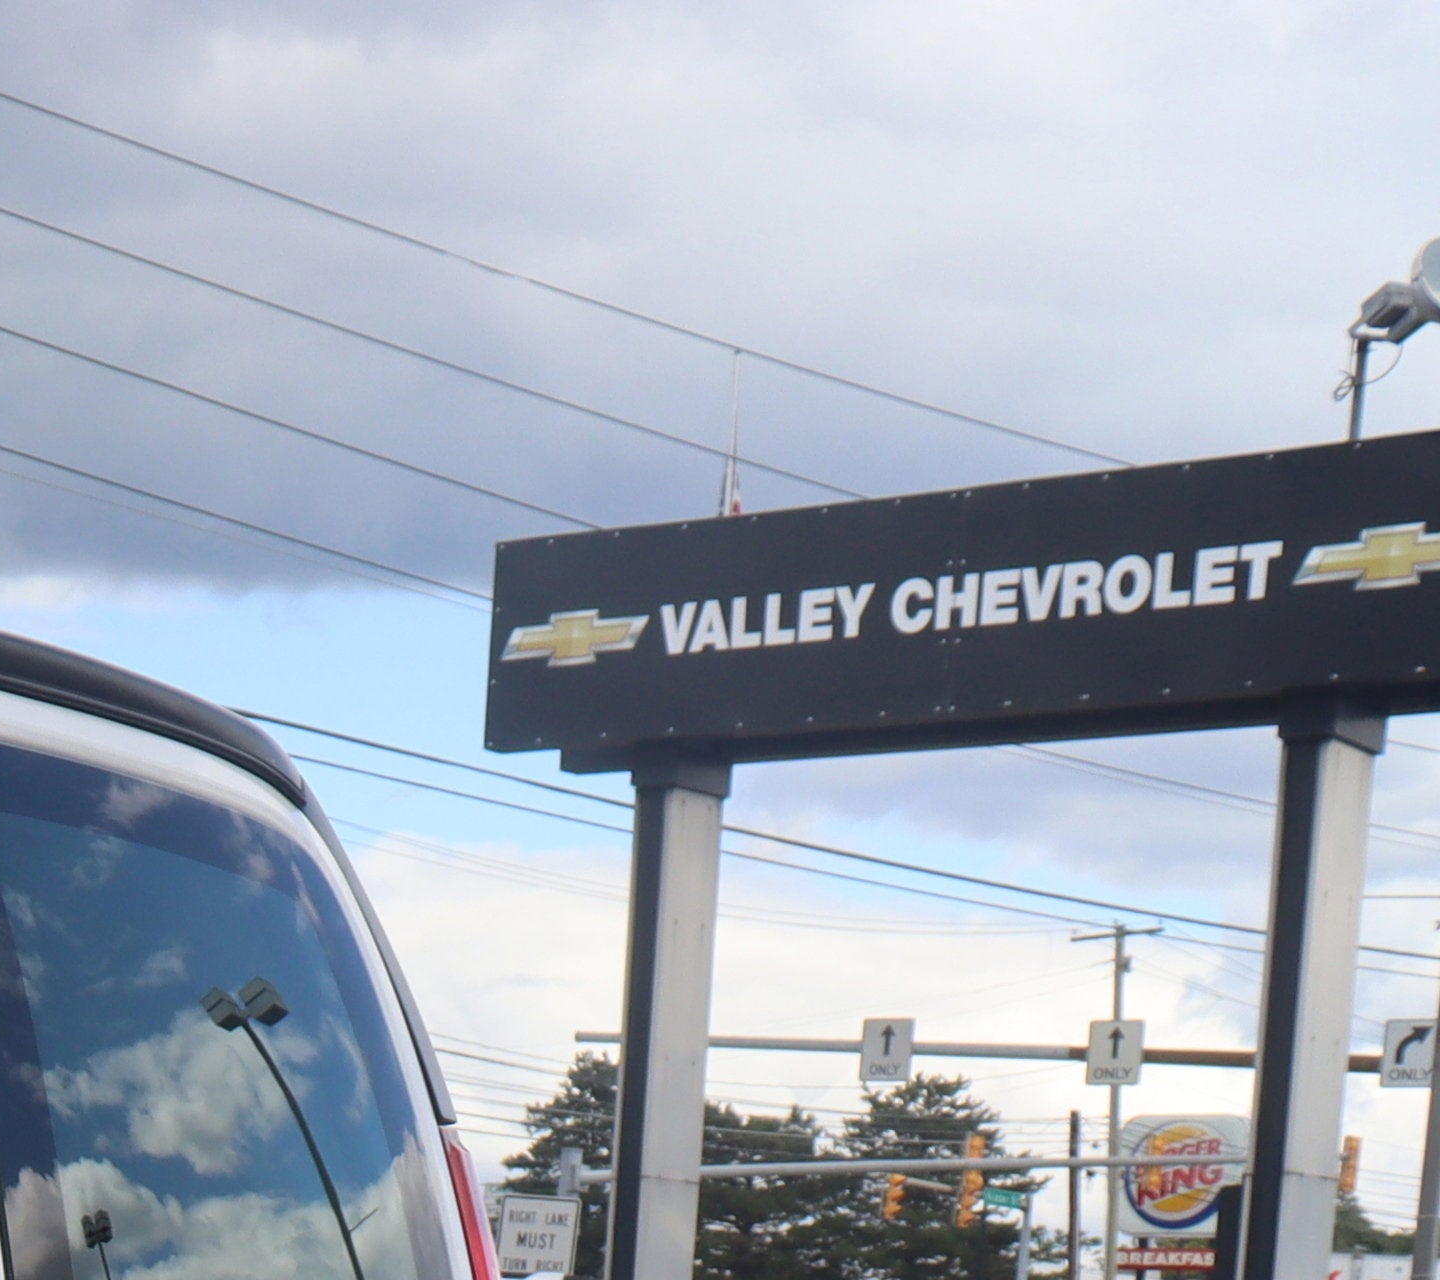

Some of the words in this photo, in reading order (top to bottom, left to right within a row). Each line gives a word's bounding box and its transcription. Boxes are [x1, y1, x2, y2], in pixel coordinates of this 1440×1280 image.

[659, 582, 875, 656] VALLEY
[890, 540, 1284, 636] CHEVROLET
[869, 1063, 901, 1076] ONLY
[1094, 1066, 1132, 1079] ONLY
[1389, 1067, 1433, 1081] ONLY
[516, 1231, 557, 1249] MUST
[1117, 1251, 1215, 1266] BREAKFAS
